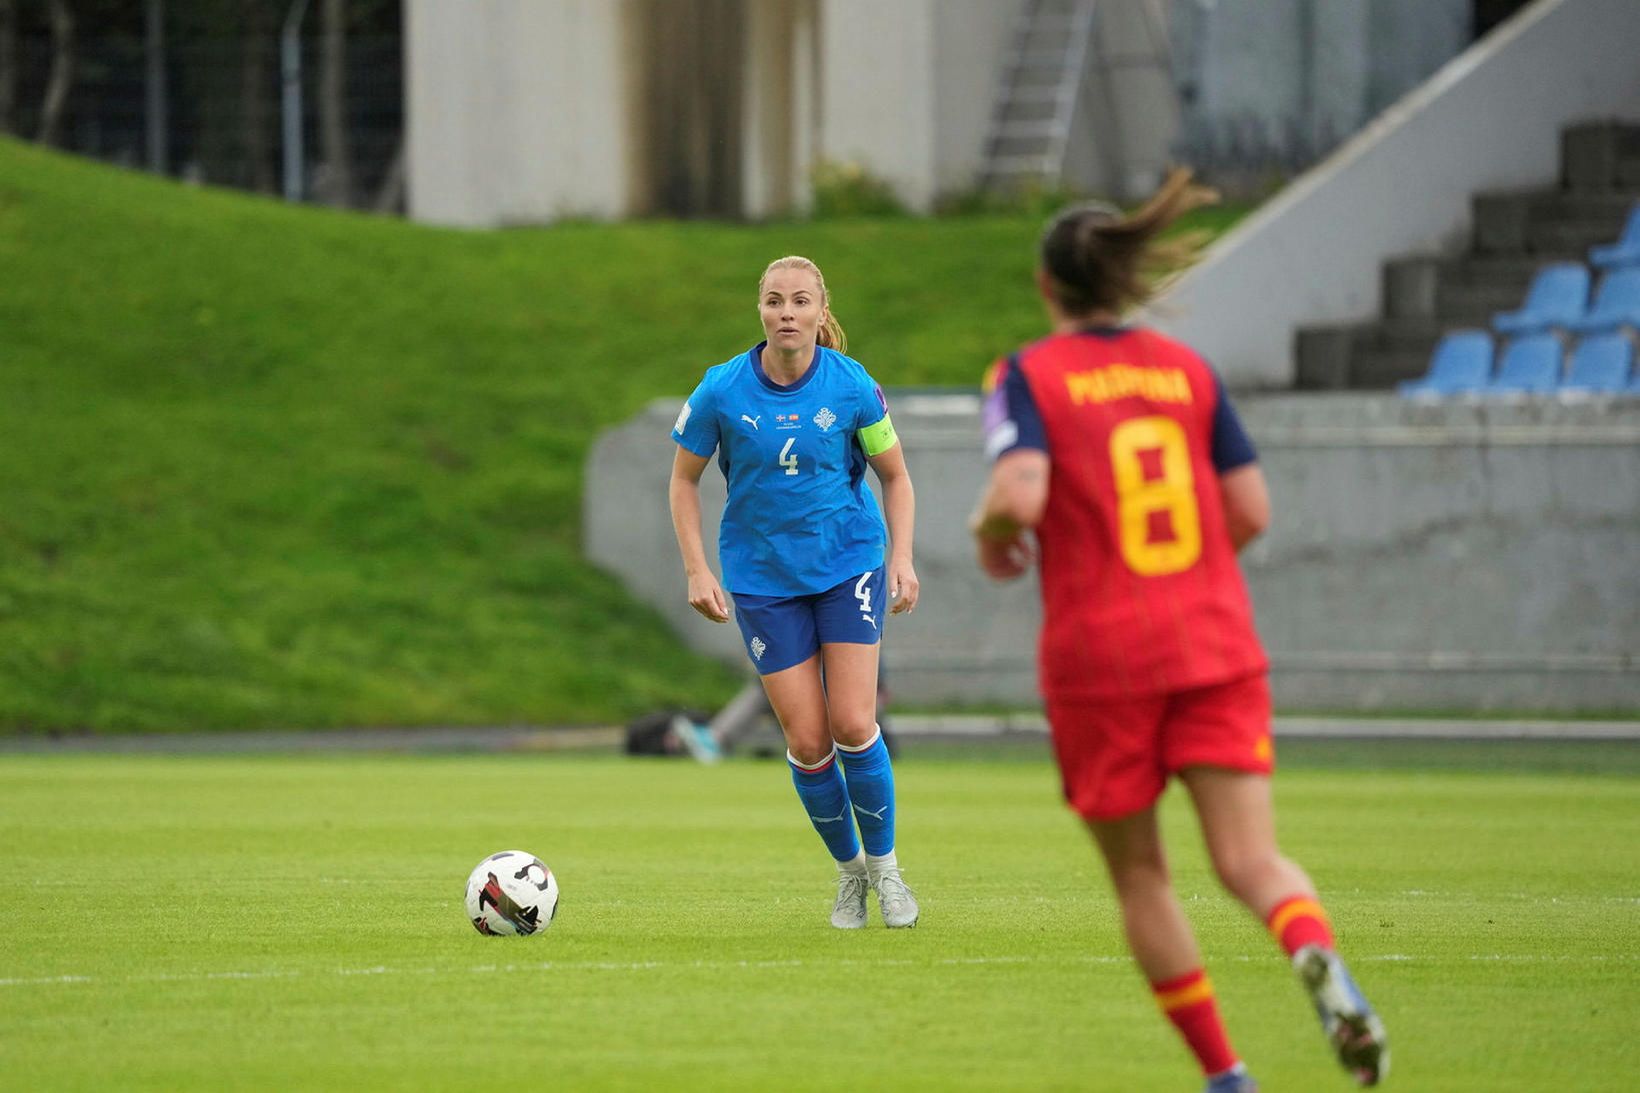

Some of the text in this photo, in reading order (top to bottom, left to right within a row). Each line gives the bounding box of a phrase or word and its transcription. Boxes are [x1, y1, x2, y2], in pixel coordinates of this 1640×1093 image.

[779, 437, 798, 475] 4
[1109, 415, 1202, 577] 8
[854, 571, 873, 612] 4
